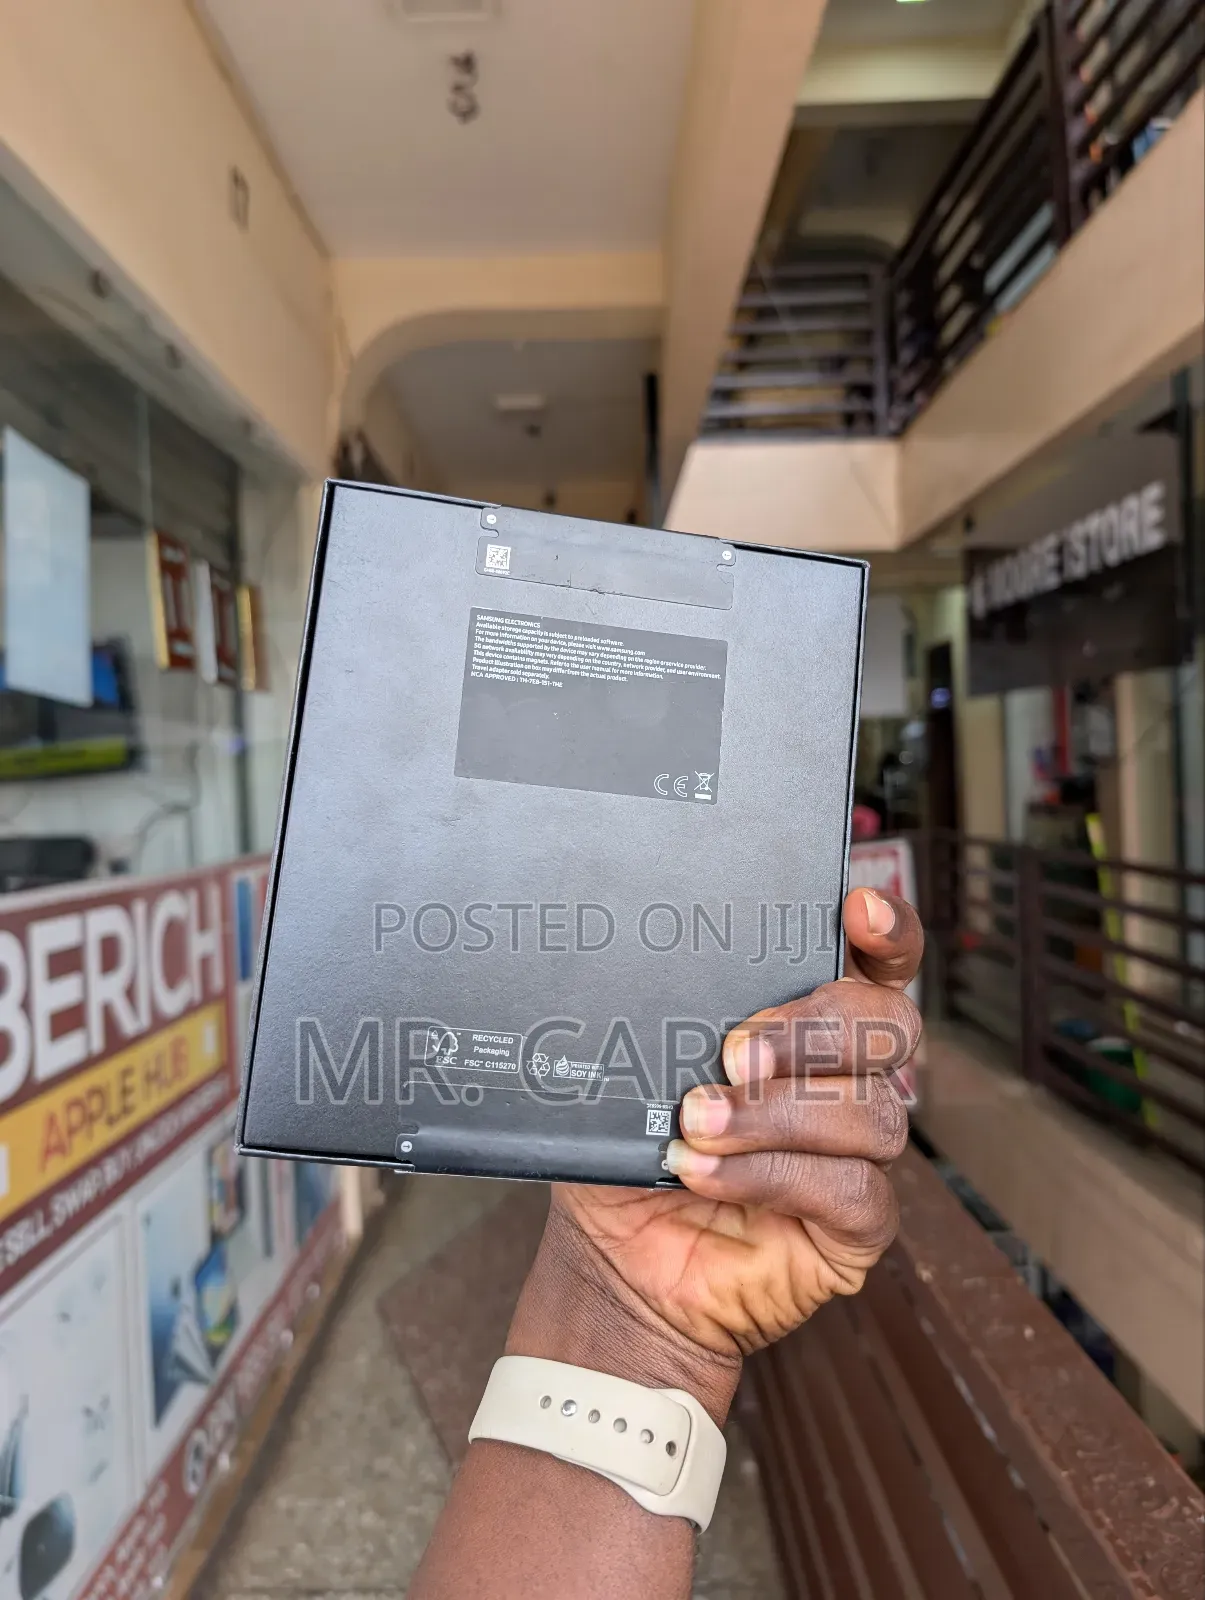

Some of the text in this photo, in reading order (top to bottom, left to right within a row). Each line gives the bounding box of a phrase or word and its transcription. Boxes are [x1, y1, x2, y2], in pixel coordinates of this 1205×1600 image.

[477, 615, 541, 628] SAMSUNG ELECTRONICS
[560, 646, 577, 654] device
[473, 656, 495, 665] Product
[485, 672, 516, 682] APPROVED
[472, 1034, 514, 1044] RECYCLED
[473, 1046, 510, 1056] Packaging
[485, 1060, 517, 1070] C115270
[570, 1069, 602, 1079] SOY INK
[41, 1065, 136, 1173] APPLE
